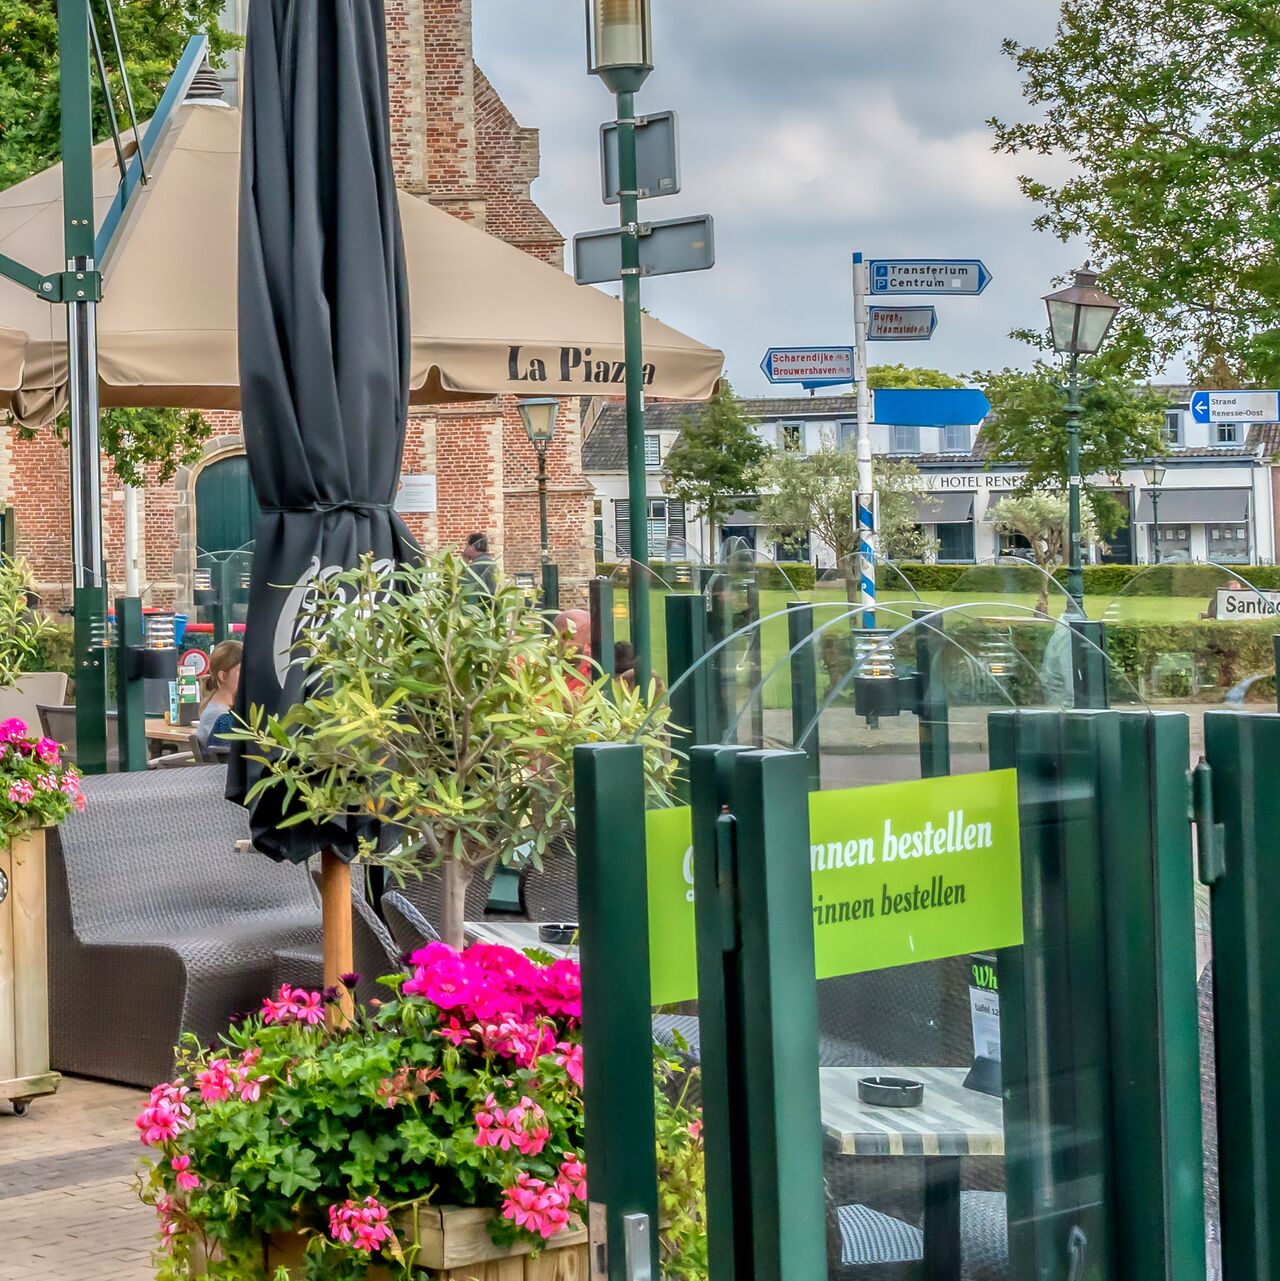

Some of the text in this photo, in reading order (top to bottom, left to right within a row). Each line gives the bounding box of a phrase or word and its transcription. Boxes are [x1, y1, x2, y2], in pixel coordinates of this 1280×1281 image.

[890, 265, 969, 275] Transferium
[890, 278, 945, 287] Centrum
[877, 324, 918, 334] Haamstede
[772, 353, 834, 364] Scharendijke
[507, 345, 656, 385] La Piaza
[773, 367, 837, 376] Brouwershaven
[1211, 409, 1264, 417] Renesse-Oost
[940, 475, 982, 488] HOTEL
[882, 809, 993, 863] bestellen
[881, 875, 967, 917] bestellen
[974, 1002, 991, 1014] tafel
